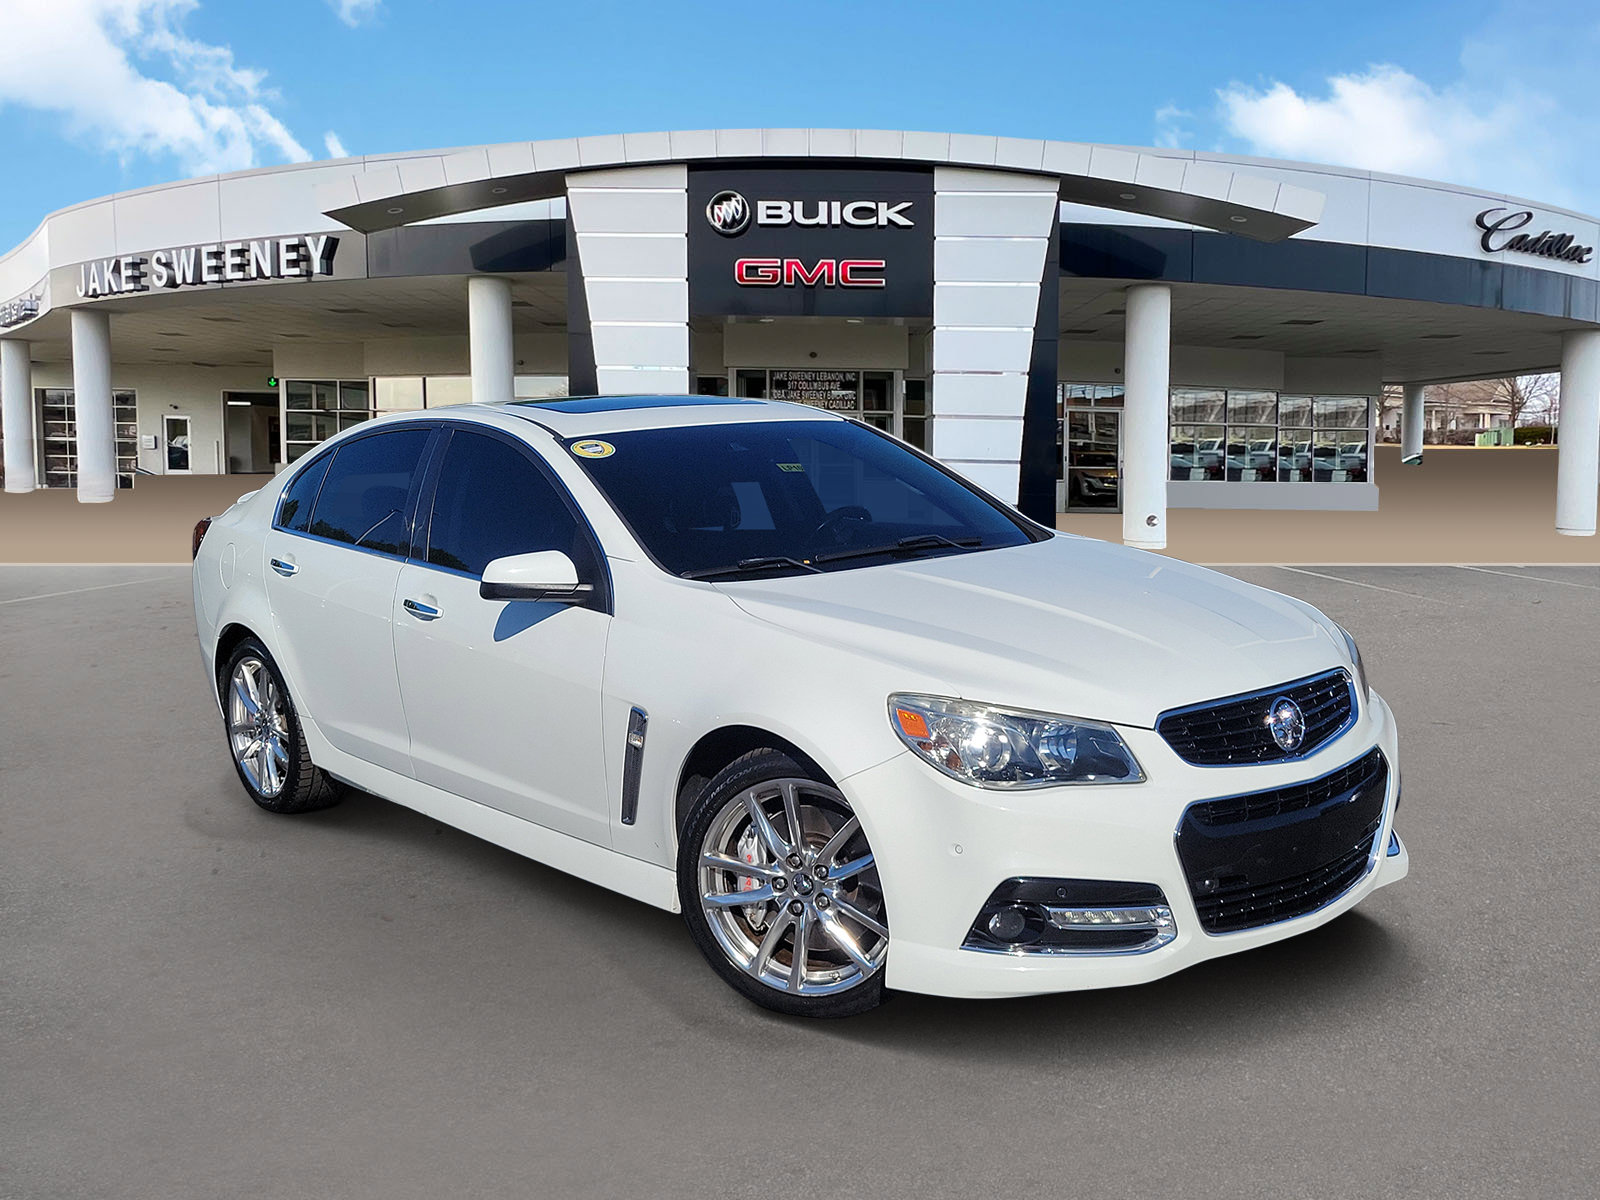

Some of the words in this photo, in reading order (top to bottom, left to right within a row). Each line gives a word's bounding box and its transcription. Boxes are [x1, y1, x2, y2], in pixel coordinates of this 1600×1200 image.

[757, 200, 915, 226] BUICK
[1475, 207, 1593, 264] Cadillac
[76, 256, 146, 298] JAKE
[151, 235, 338, 289] SWEENEY
[735, 258, 886, 287] GMC
[773, 372, 788, 381] JAKE
[788, 372, 815, 381] SWEENEY
